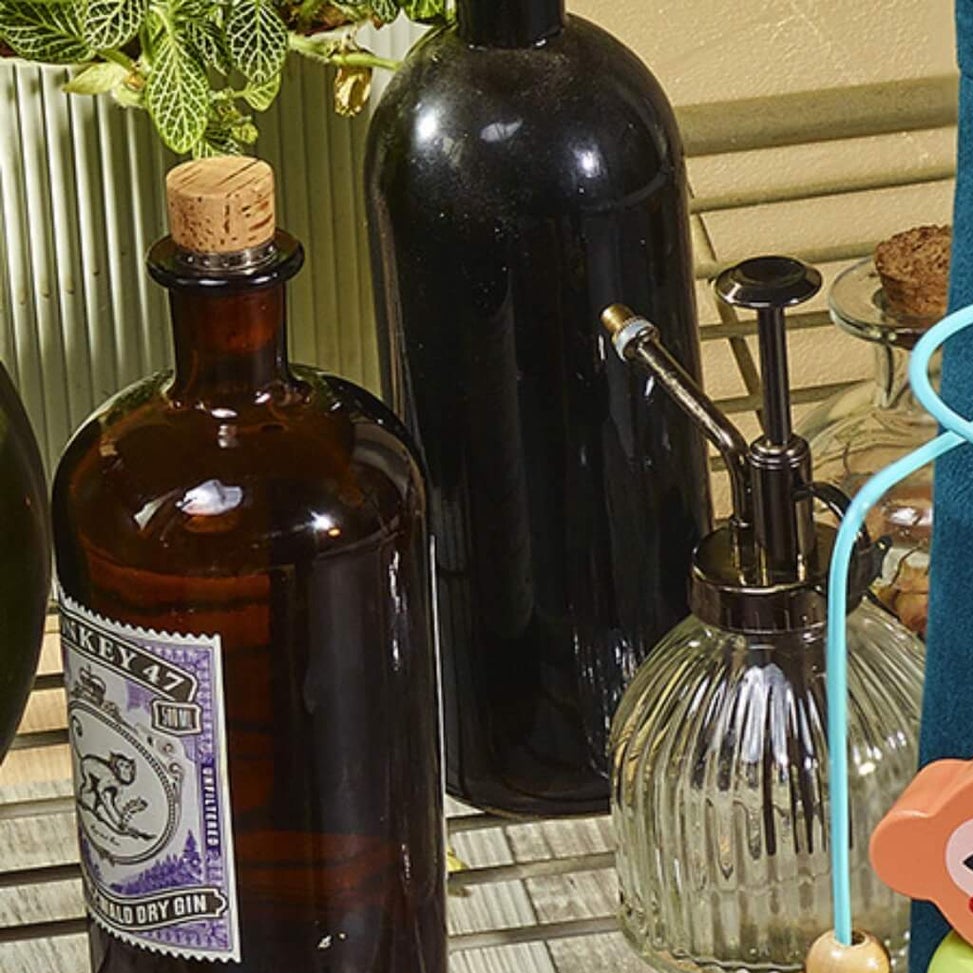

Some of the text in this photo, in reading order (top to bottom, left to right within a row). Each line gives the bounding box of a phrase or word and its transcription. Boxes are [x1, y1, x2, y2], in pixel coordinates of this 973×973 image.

[142, 663, 185, 692] 47
[135, 899, 170, 924] DRY
[173, 893, 208, 917] GIN
